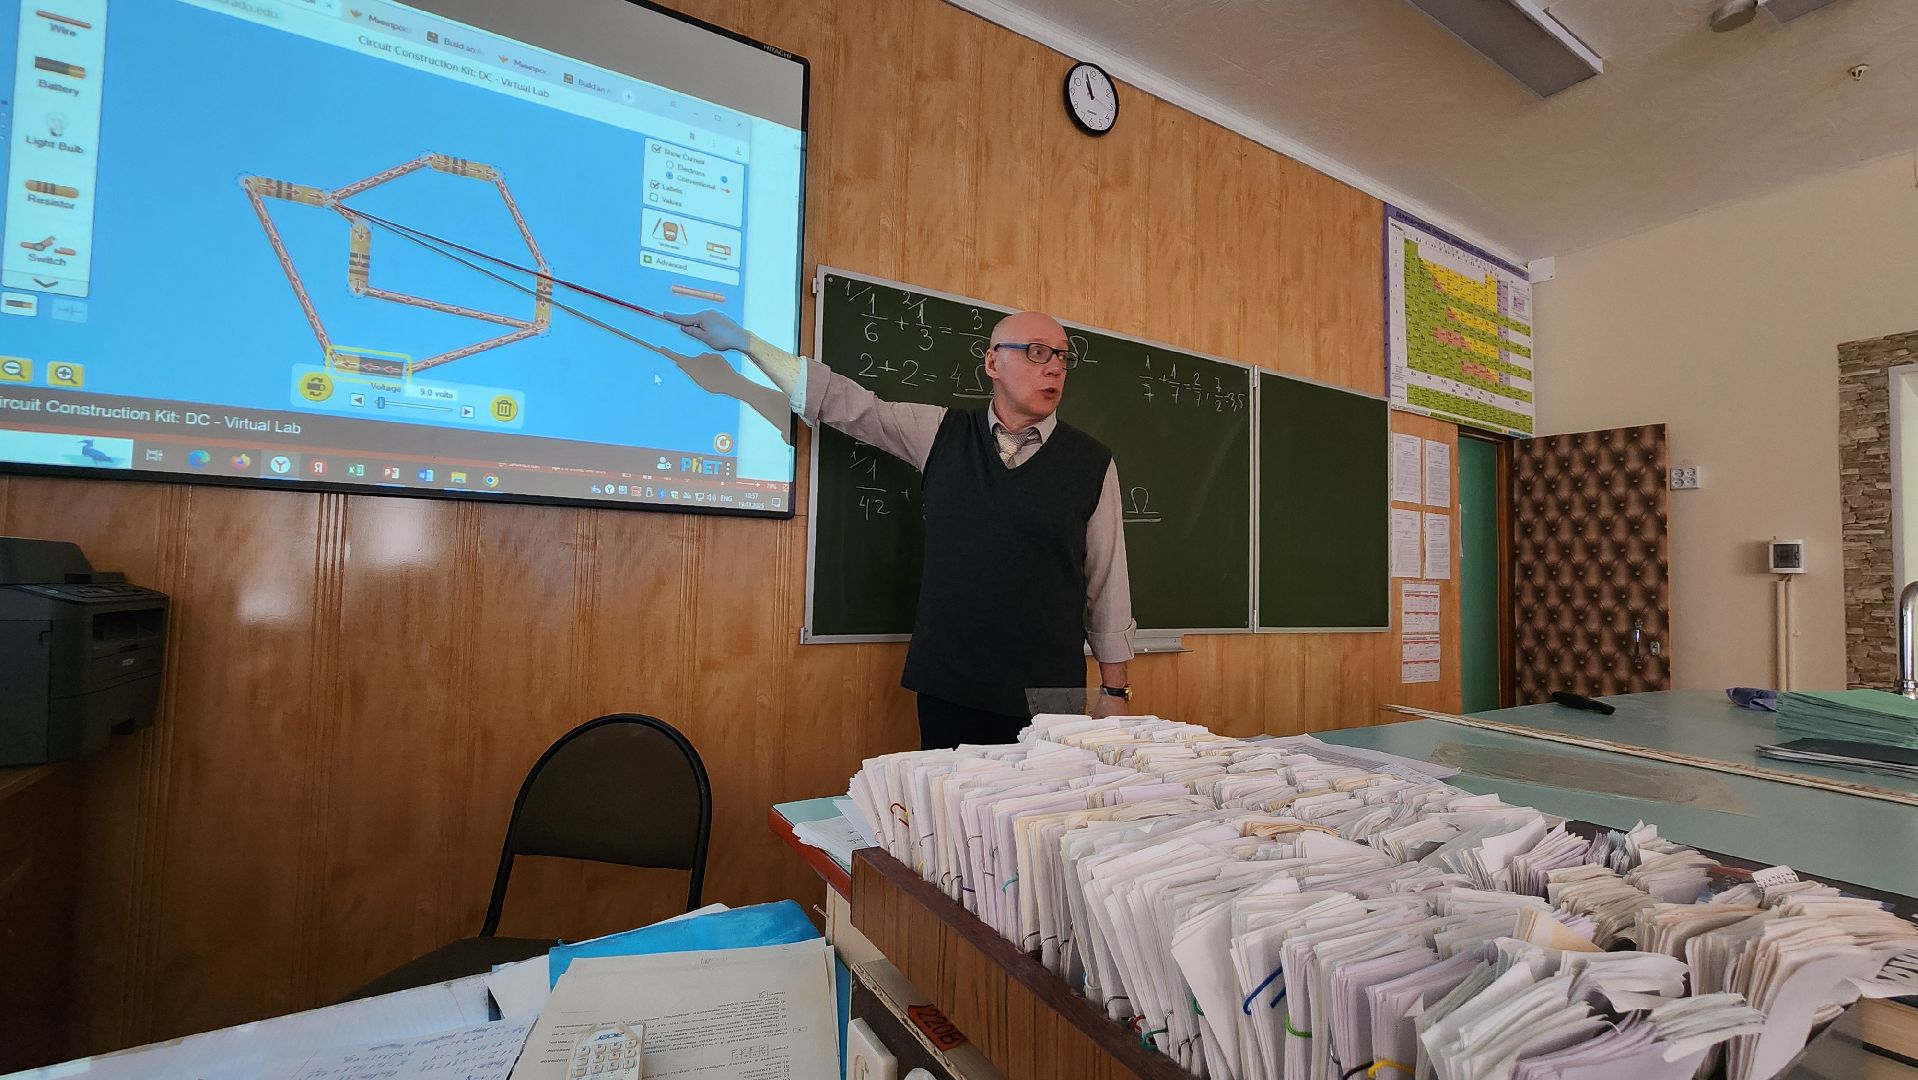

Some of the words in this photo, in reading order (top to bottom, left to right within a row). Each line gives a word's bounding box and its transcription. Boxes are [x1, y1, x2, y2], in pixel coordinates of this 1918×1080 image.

[49, 23, 77, 37] Wire
[443, 37, 465, 50] Build
[763, 44, 792, 59] HITACHI
[358, 35, 392, 53] Circuit
[394, 46, 459, 71] Construction
[461, 65, 477, 77] Kit:
[478, 70, 493, 82] DC
[500, 76, 531, 93] Virtual
[532, 86, 549, 98] Lab
[38, 80, 79, 97] Battery
[578, 79, 596, 91] Build
[1105, 88, 1112, 98] 2
[1108, 103, 1114, 112] 3
[1088, 118, 1095, 128] 6
[1104, 113, 1110, 122] 4
[25, 135, 55, 149] Light
[58, 142, 84, 154] Bulb
[677, 164, 706, 177] Electrons
[677, 175, 715, 190] Conventional
[662, 184, 683, 195] Labels
[27, 194, 75, 210] Resistor
[662, 196, 682, 207] Values
[28, 253, 67, 267] Switch
[655, 257, 688, 270] Advanced
[371, 382, 401, 393] Voltage
[435, 391, 454, 400] volts
[0, 396, 41, 411] ircuit
[46, 399, 151, 421] Construction
[154, 409, 181, 424] Kit:
[185, 412, 211, 426] DC
[224, 415, 271, 432] Virtual
[275, 421, 301, 434] Lab
[720, 494, 733, 503] ENG
